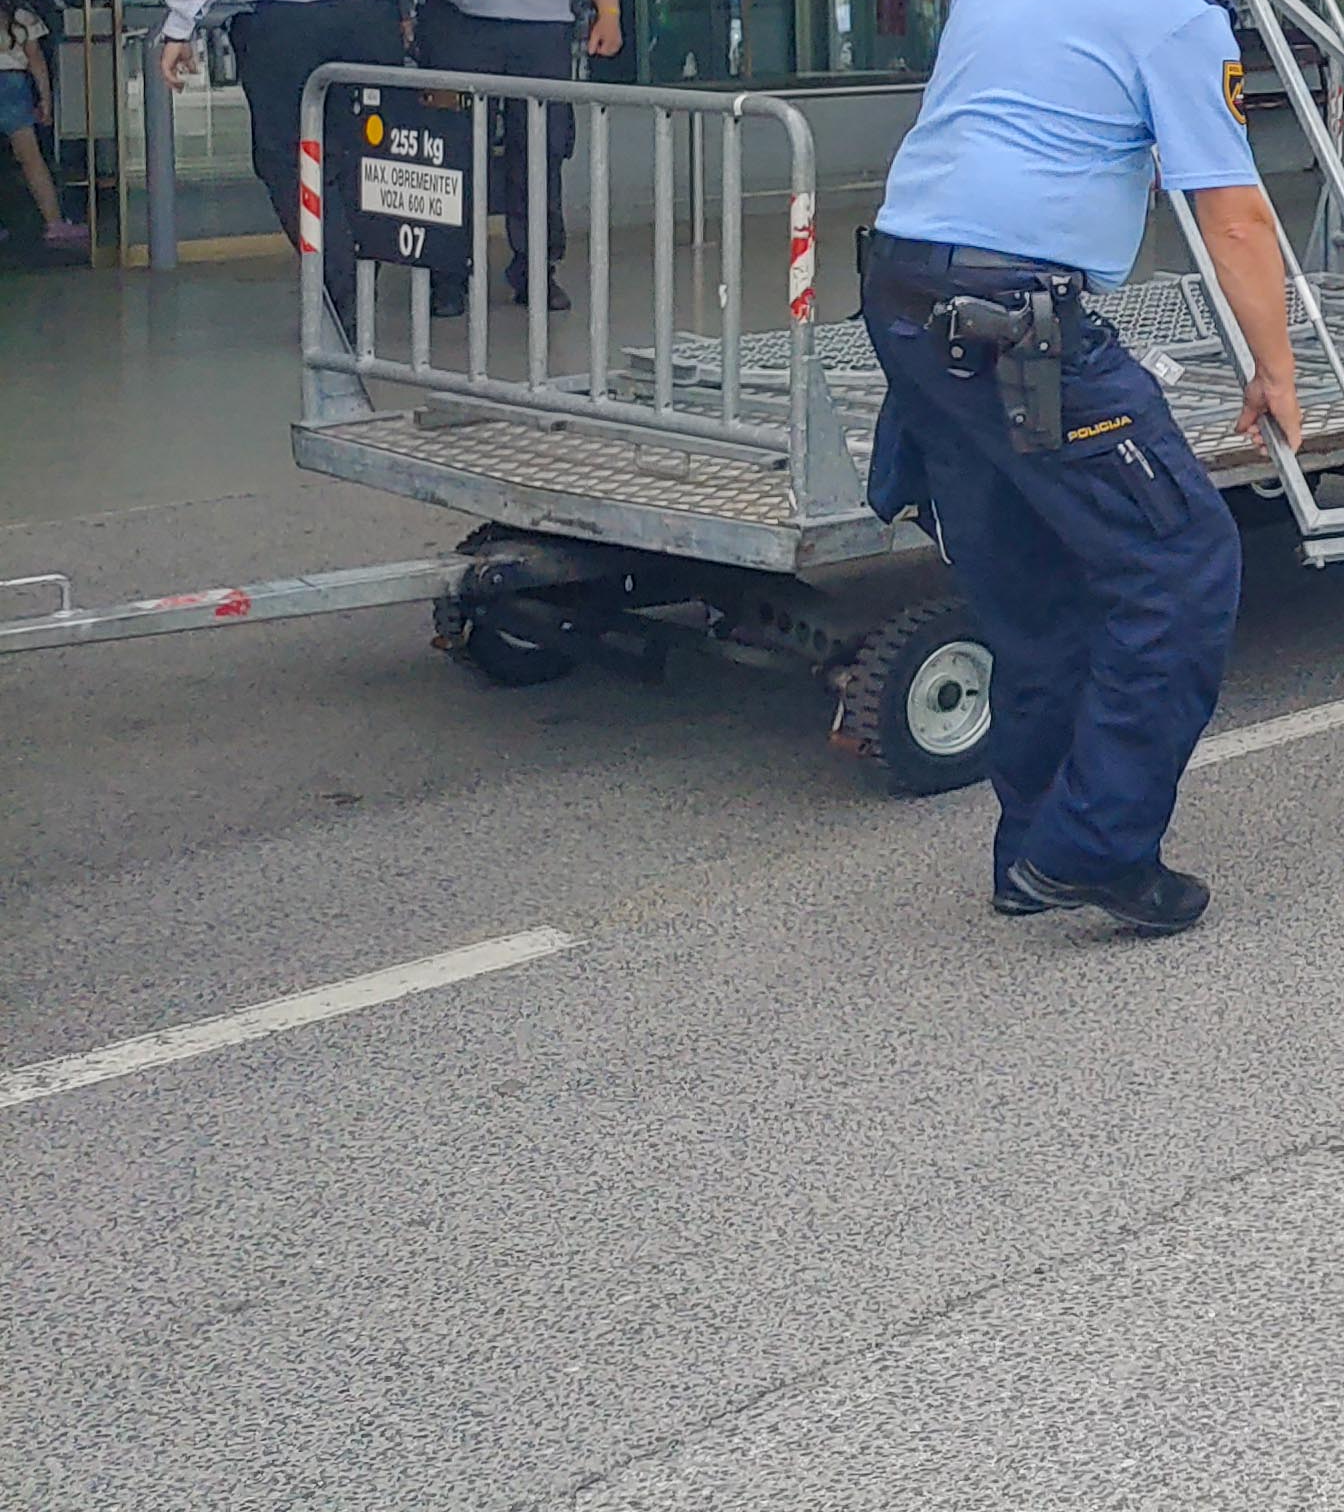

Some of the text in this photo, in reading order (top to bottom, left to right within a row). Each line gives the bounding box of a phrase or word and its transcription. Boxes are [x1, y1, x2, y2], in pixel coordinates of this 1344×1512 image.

[390, 127, 444, 165] 255 kg
[364, 163, 458, 197] MAX. OBREMENITEV
[380, 189, 443, 217] VOZA 600 KG
[399, 223, 426, 259] 07
[1067, 415, 1133, 443] POLICIJA
